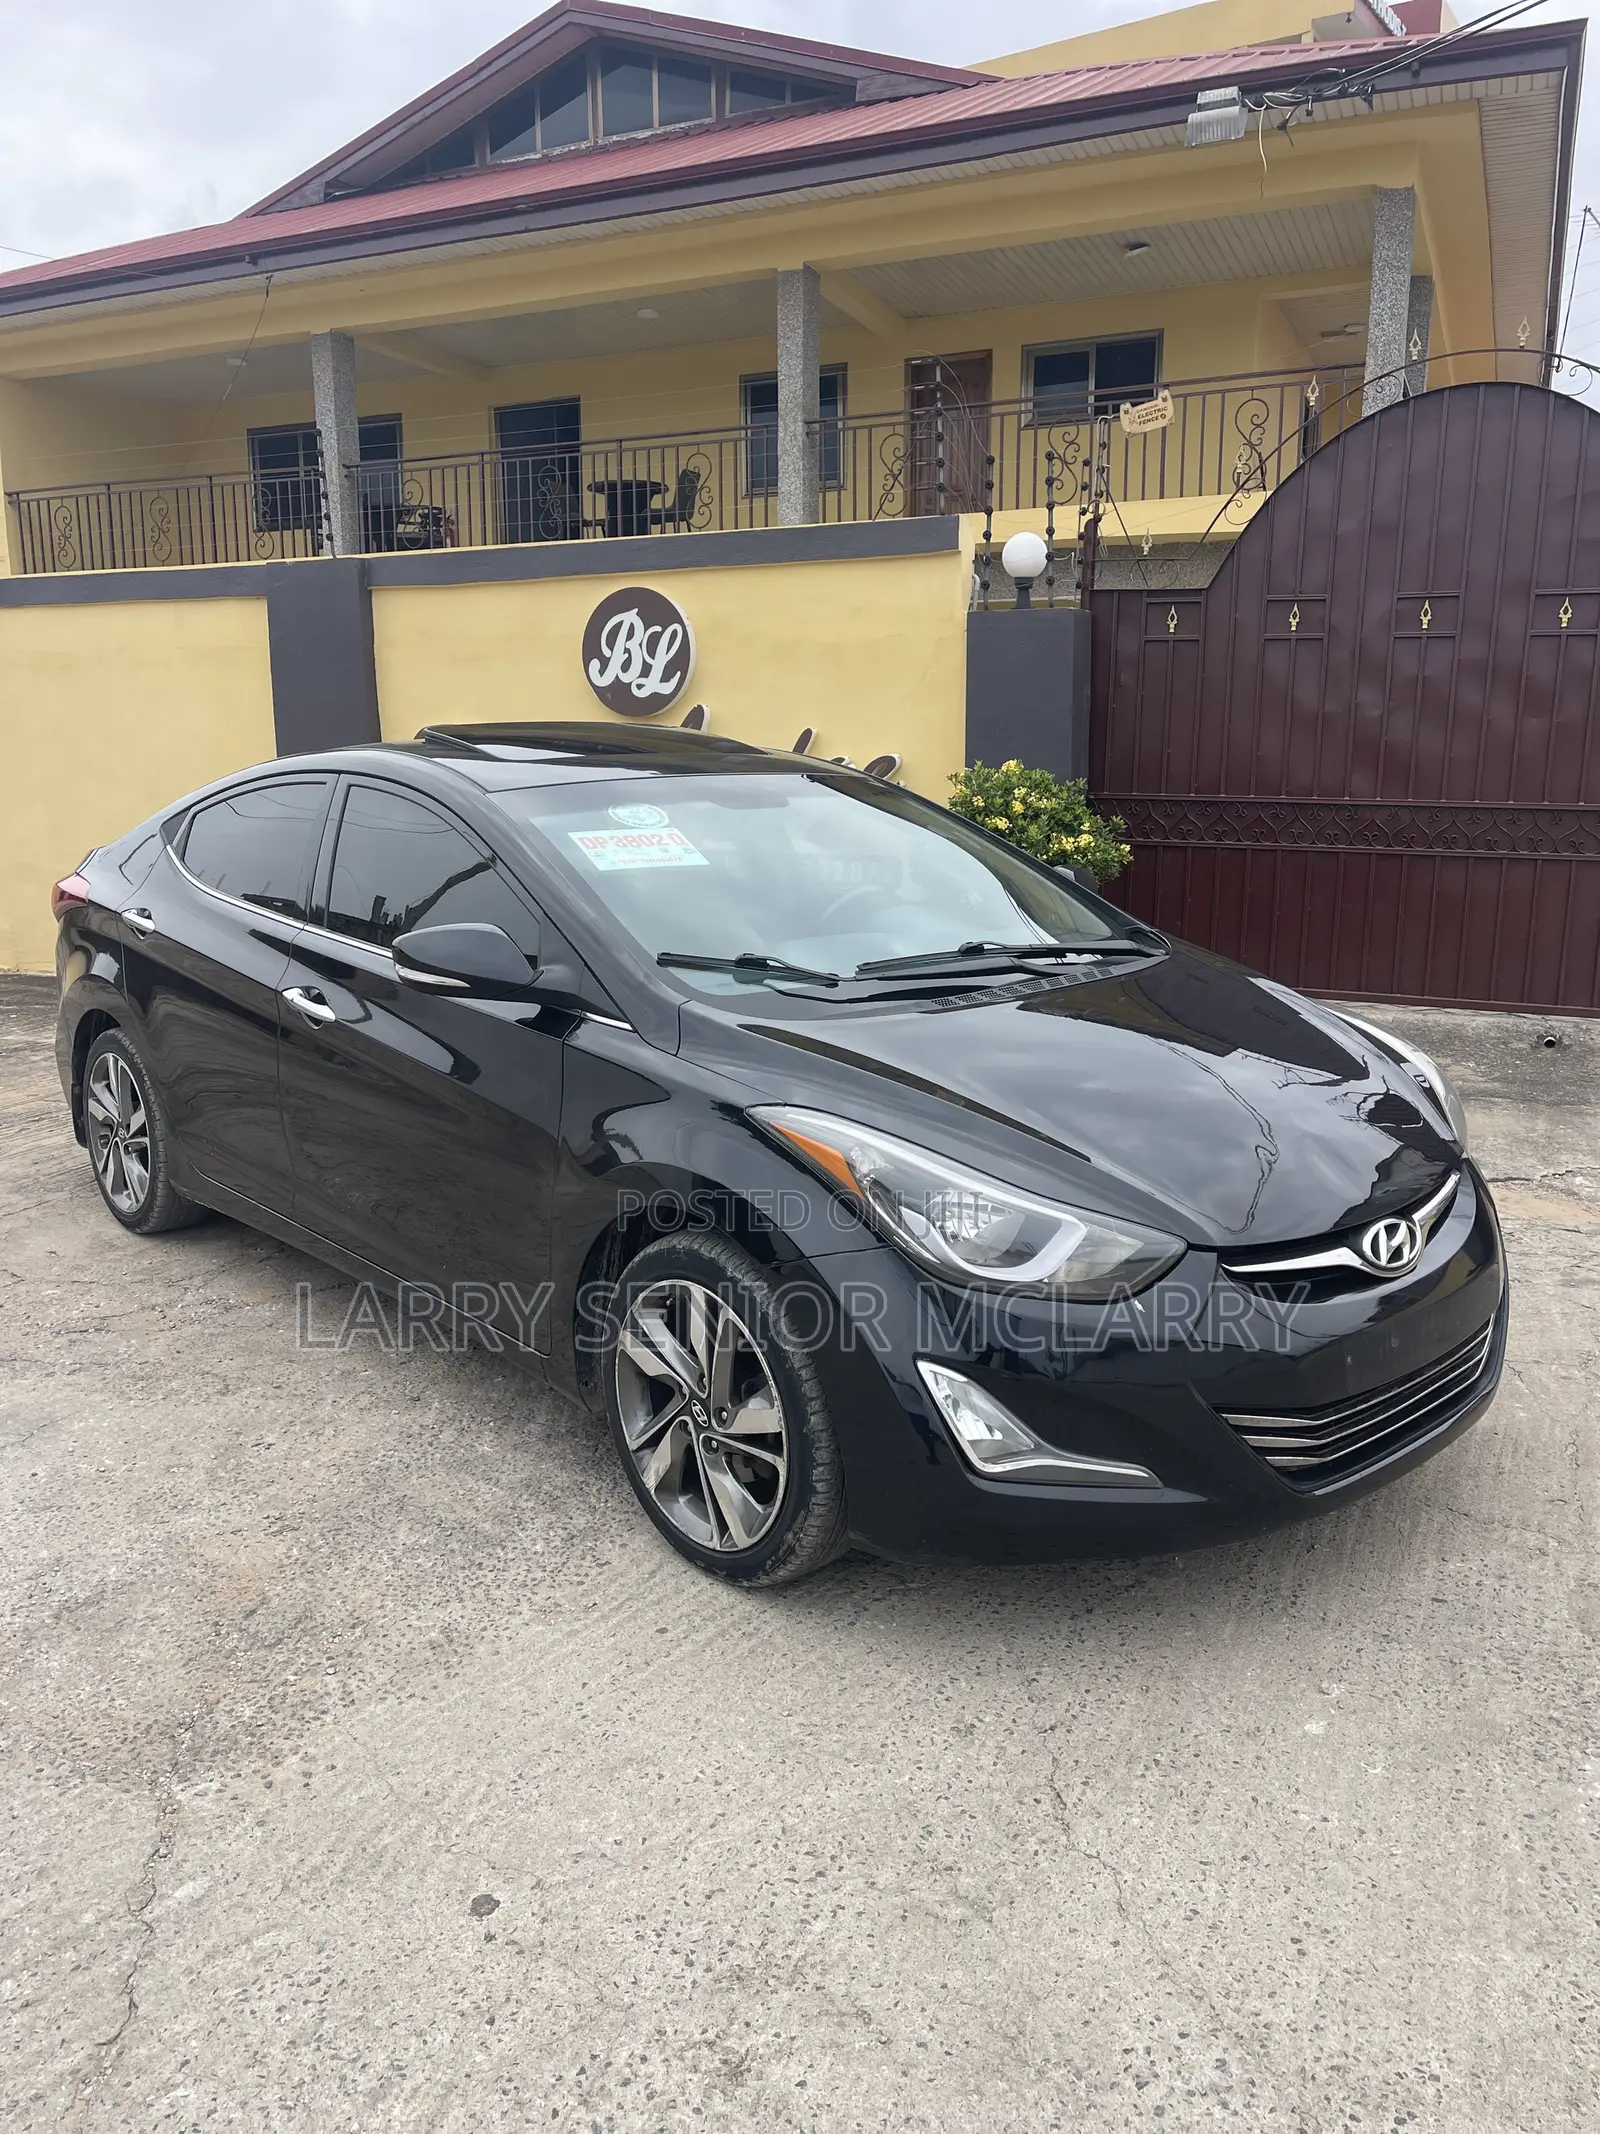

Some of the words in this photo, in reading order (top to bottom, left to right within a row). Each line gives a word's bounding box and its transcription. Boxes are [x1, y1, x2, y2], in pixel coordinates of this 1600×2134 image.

[1137, 406, 1168, 420] ELECTRIC
[1138, 415, 1160, 426] FENCE
[588, 607, 682, 698] BL
[608, 834, 670, 849] 3802
